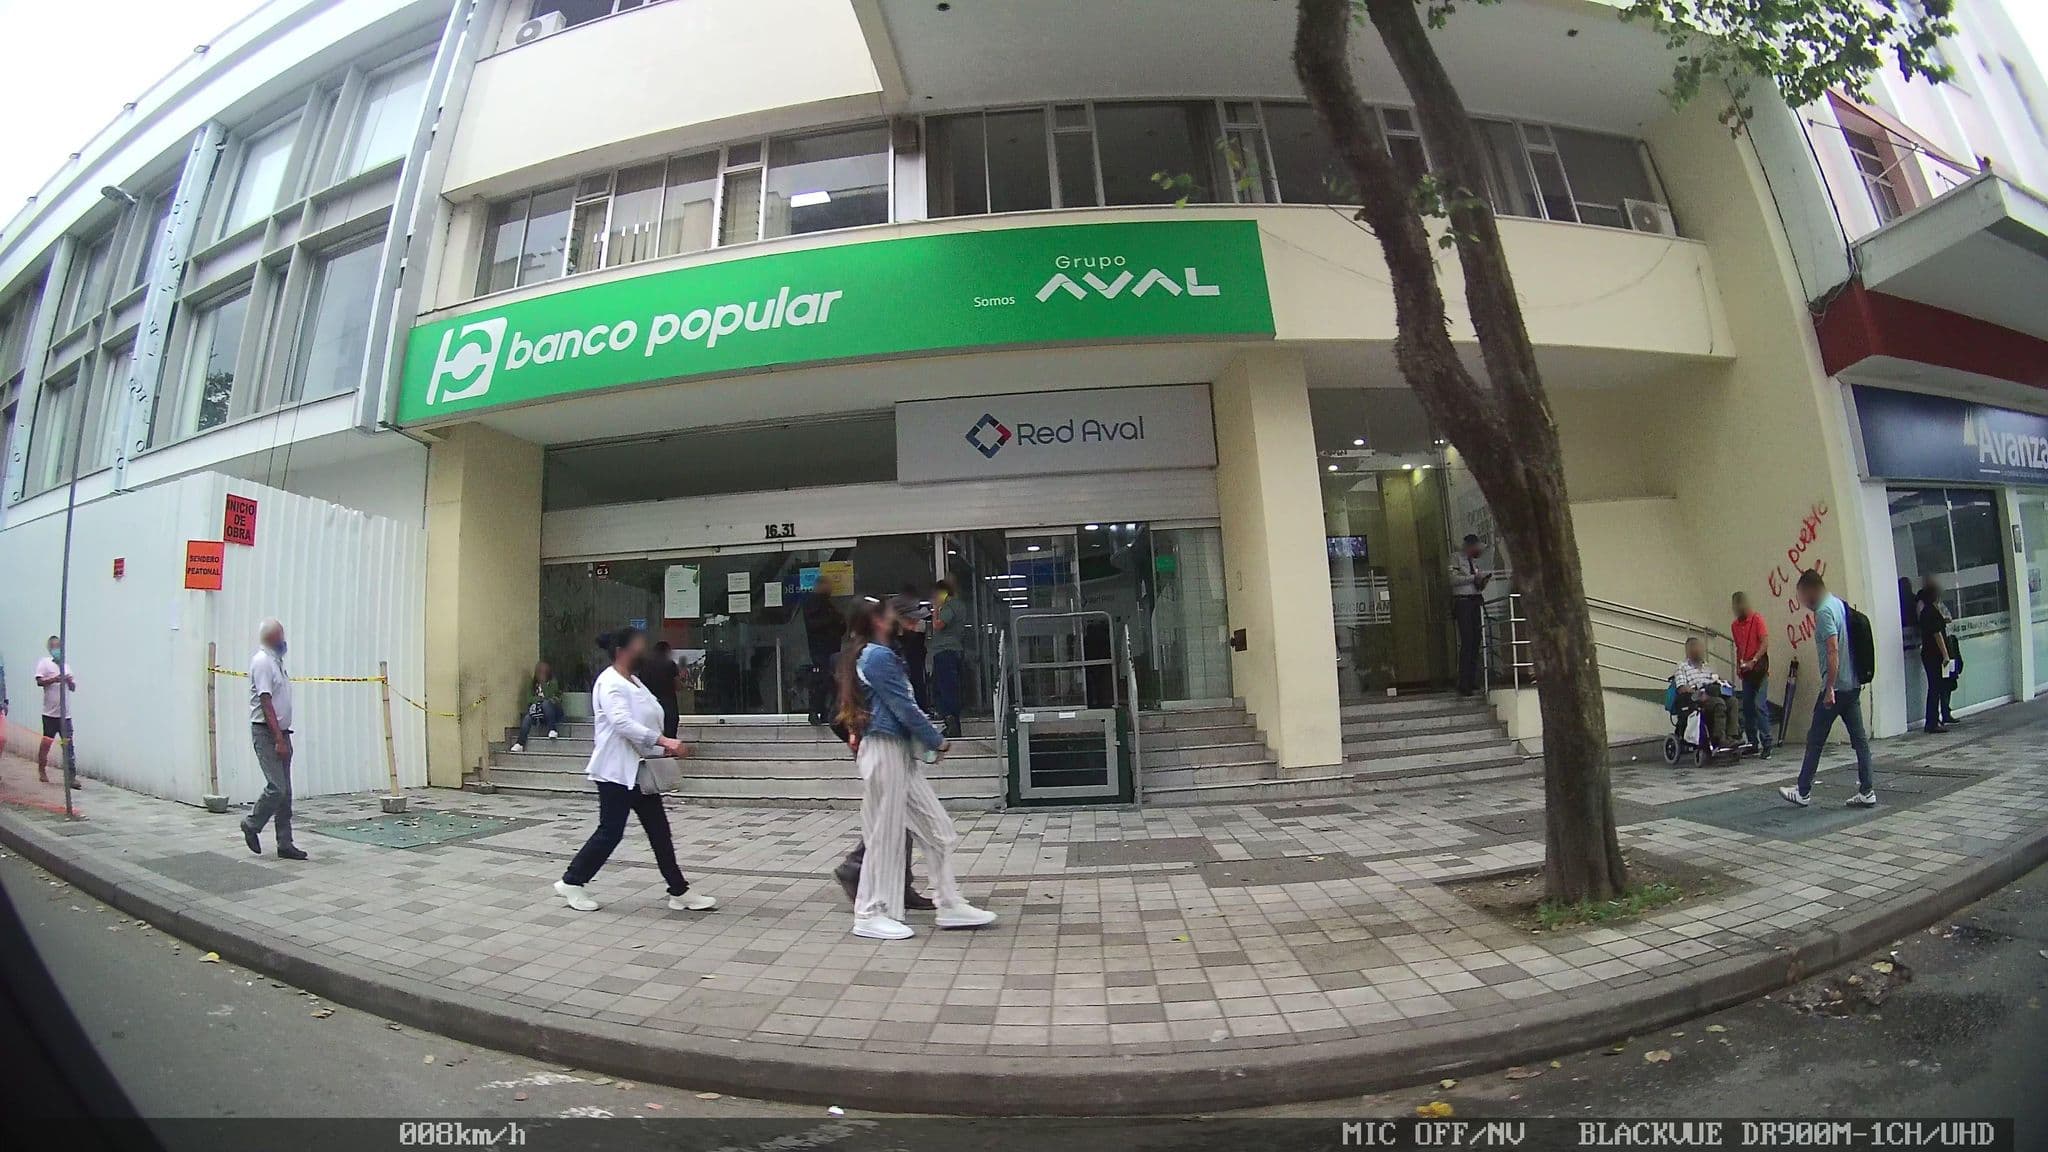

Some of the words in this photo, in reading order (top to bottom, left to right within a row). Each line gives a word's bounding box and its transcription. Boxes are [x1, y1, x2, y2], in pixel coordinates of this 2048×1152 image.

[1055, 255, 1126, 270] Grupo
[1035, 267, 1221, 303] AVAL
[974, 296, 1016, 308] Somos
[504, 320, 638, 372] banco
[644, 286, 843, 358] popular
[1016, 419, 1074, 446] Red
[1081, 416, 1145, 442] Aval
[229, 500, 255, 516] INICIO
[234, 514, 246, 526] DE
[226, 526, 251, 540] OBRA
[189, 554, 220, 564] SENDERO
[187, 567, 221, 576] PEATONAL
